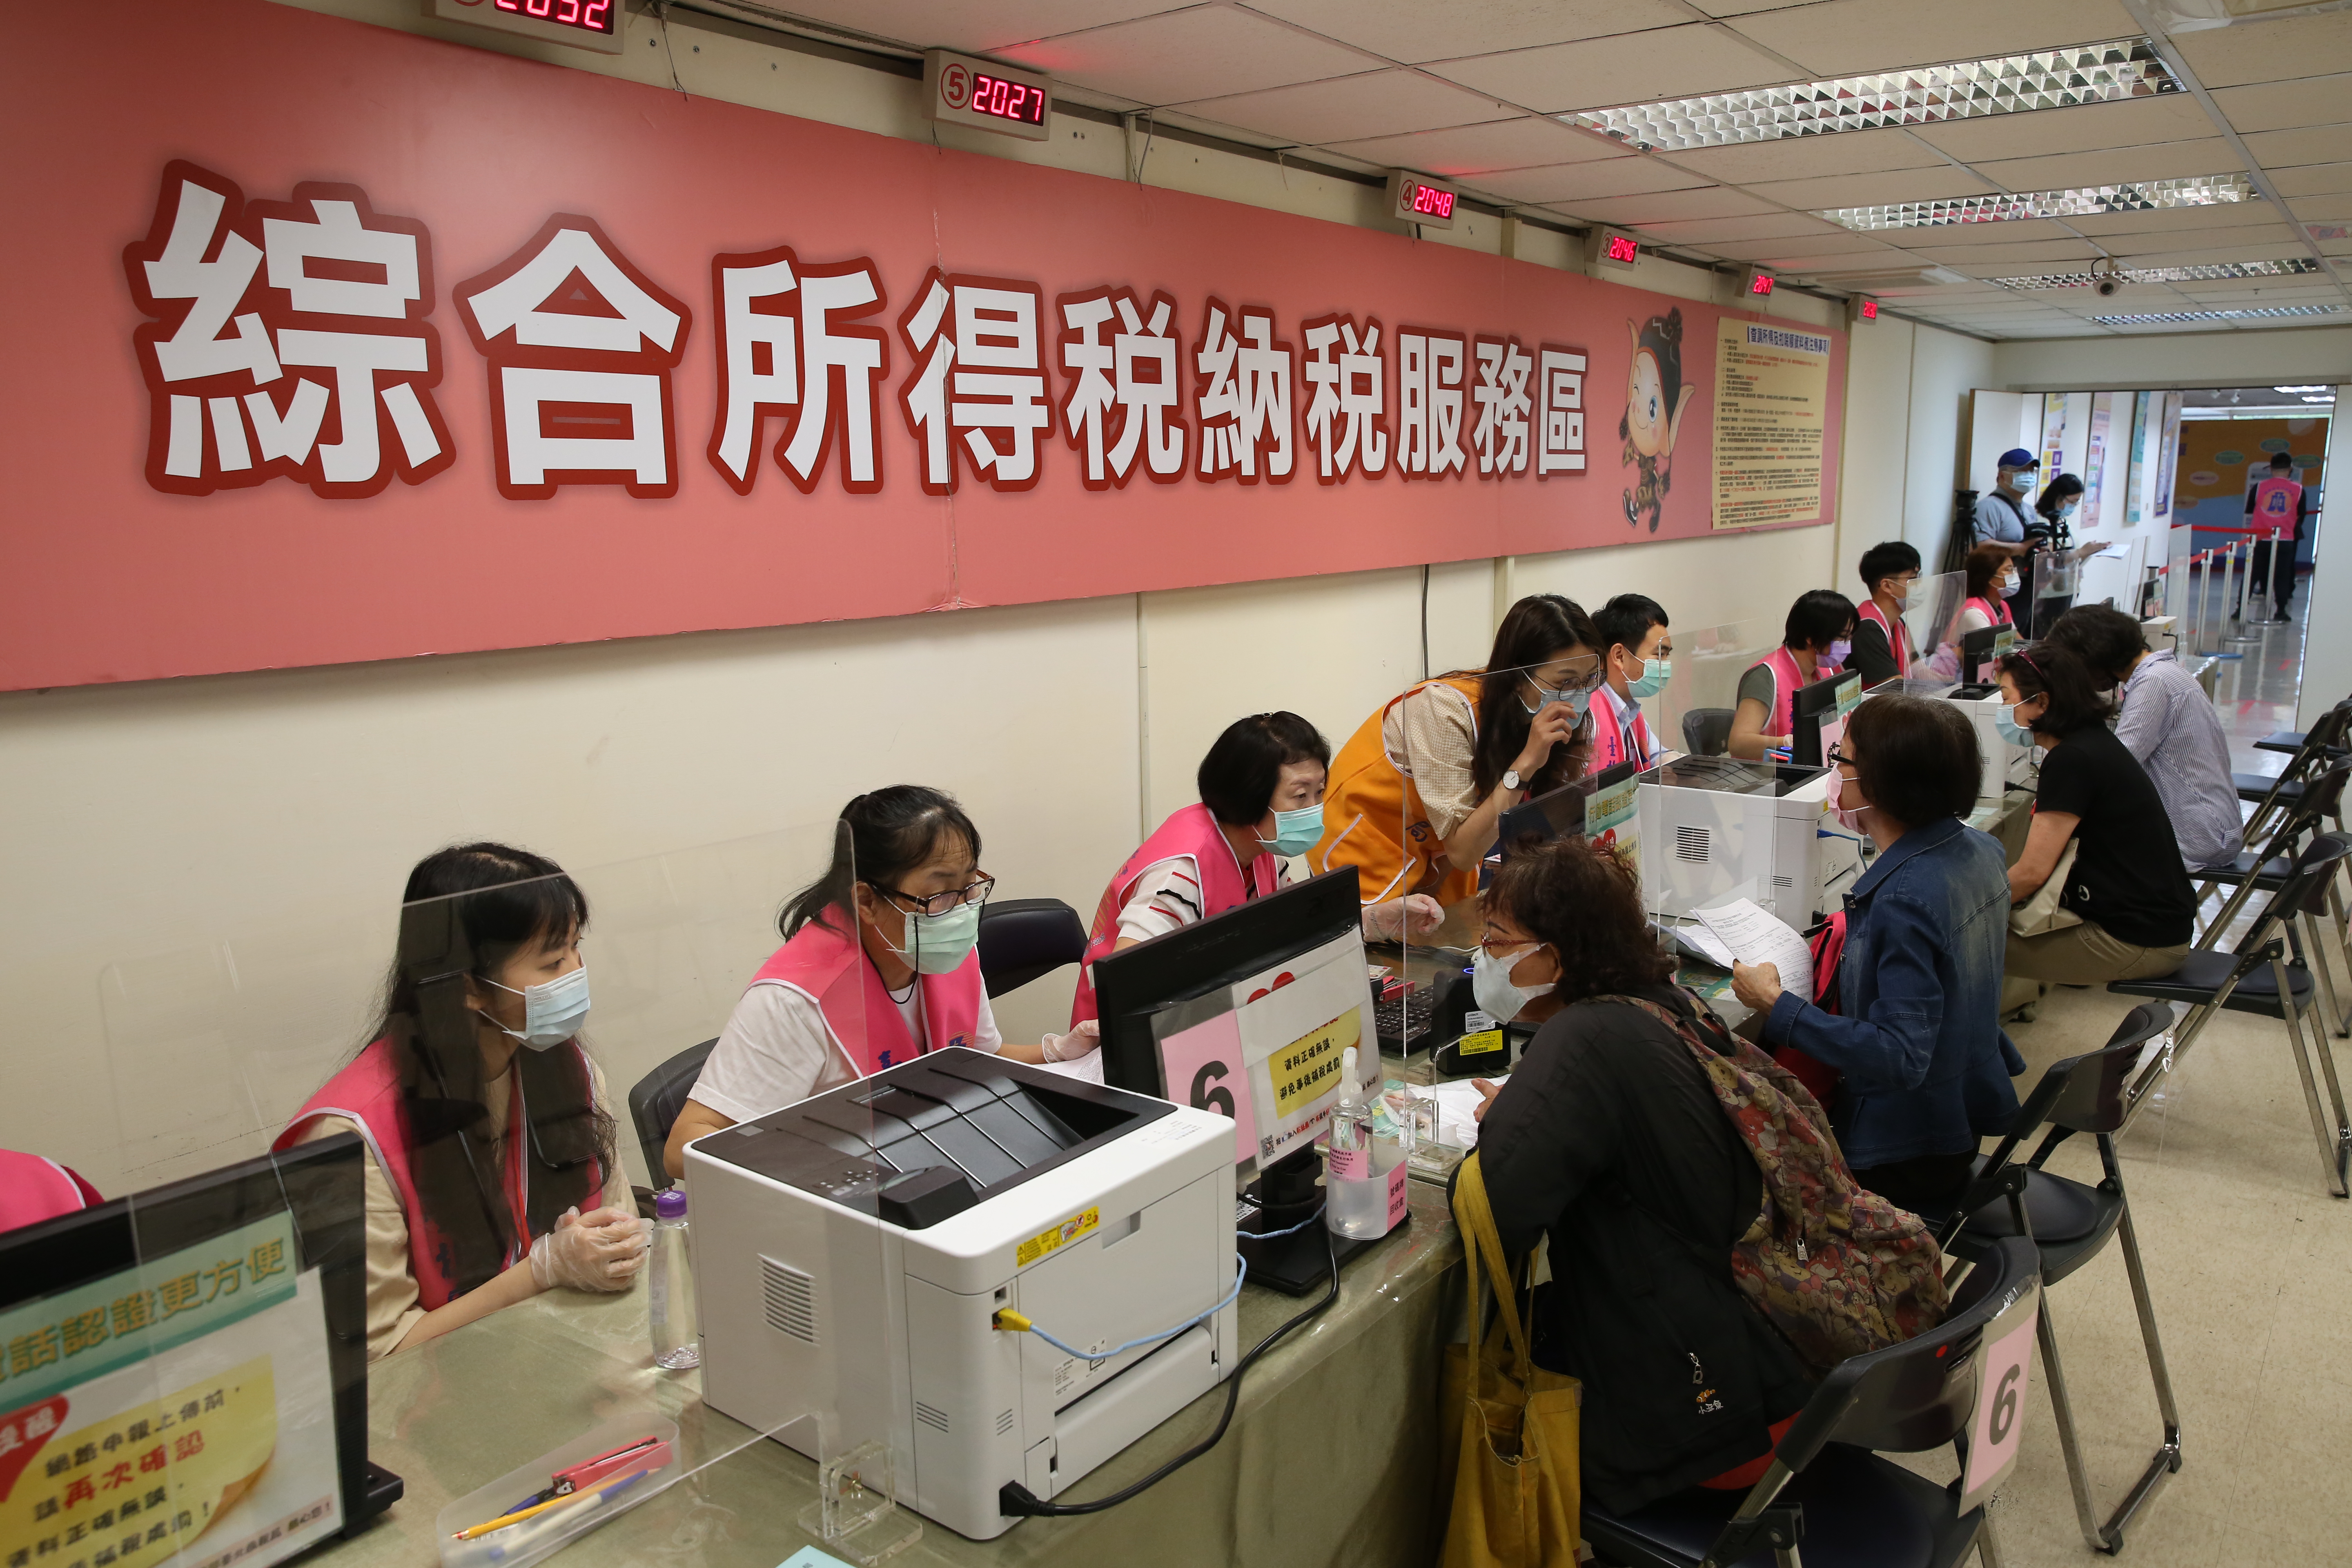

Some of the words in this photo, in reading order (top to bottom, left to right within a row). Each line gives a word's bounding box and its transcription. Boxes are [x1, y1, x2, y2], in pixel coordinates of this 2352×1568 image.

[948, 71, 964, 101] 5
[973, 77, 1042, 121] 2027
[1403, 185, 1412, 205] 4
[1415, 187, 1453, 217] 2048
[1603, 237, 1610, 253] 3
[1610, 237, 1637, 261] 2046
[144, 178, 1586, 485] 綜合所得稅納稅服務區
[1190, 1060, 1235, 1119] 6
[1279, 1054, 1343, 1100] 避免事後補稅處罰
[1390, 1197, 1404, 1216] 回收盒
[0, 1238, 287, 1382] 話認證更方便
[1989, 1363, 2021, 1446] 6
